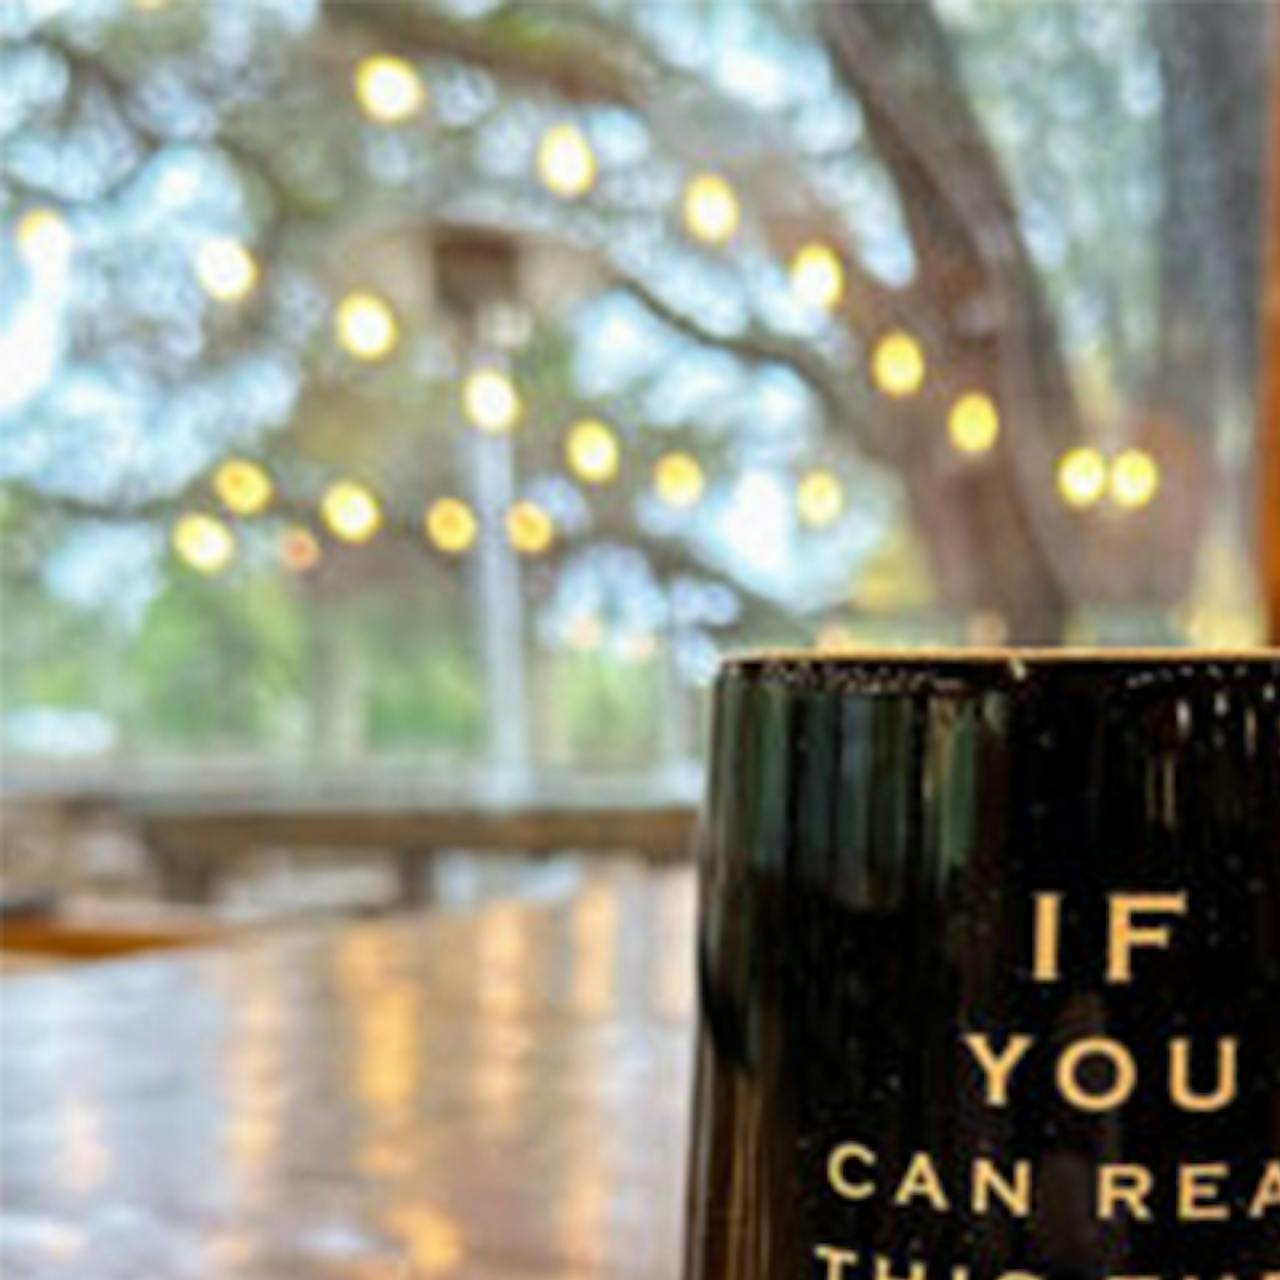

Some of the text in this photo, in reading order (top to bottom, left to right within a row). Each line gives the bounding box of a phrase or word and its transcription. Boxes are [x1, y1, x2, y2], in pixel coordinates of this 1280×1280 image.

[1031, 890, 1188, 984] IF
[963, 1031, 1237, 1112] YOU
[826, 1142, 1032, 1218] CAN
